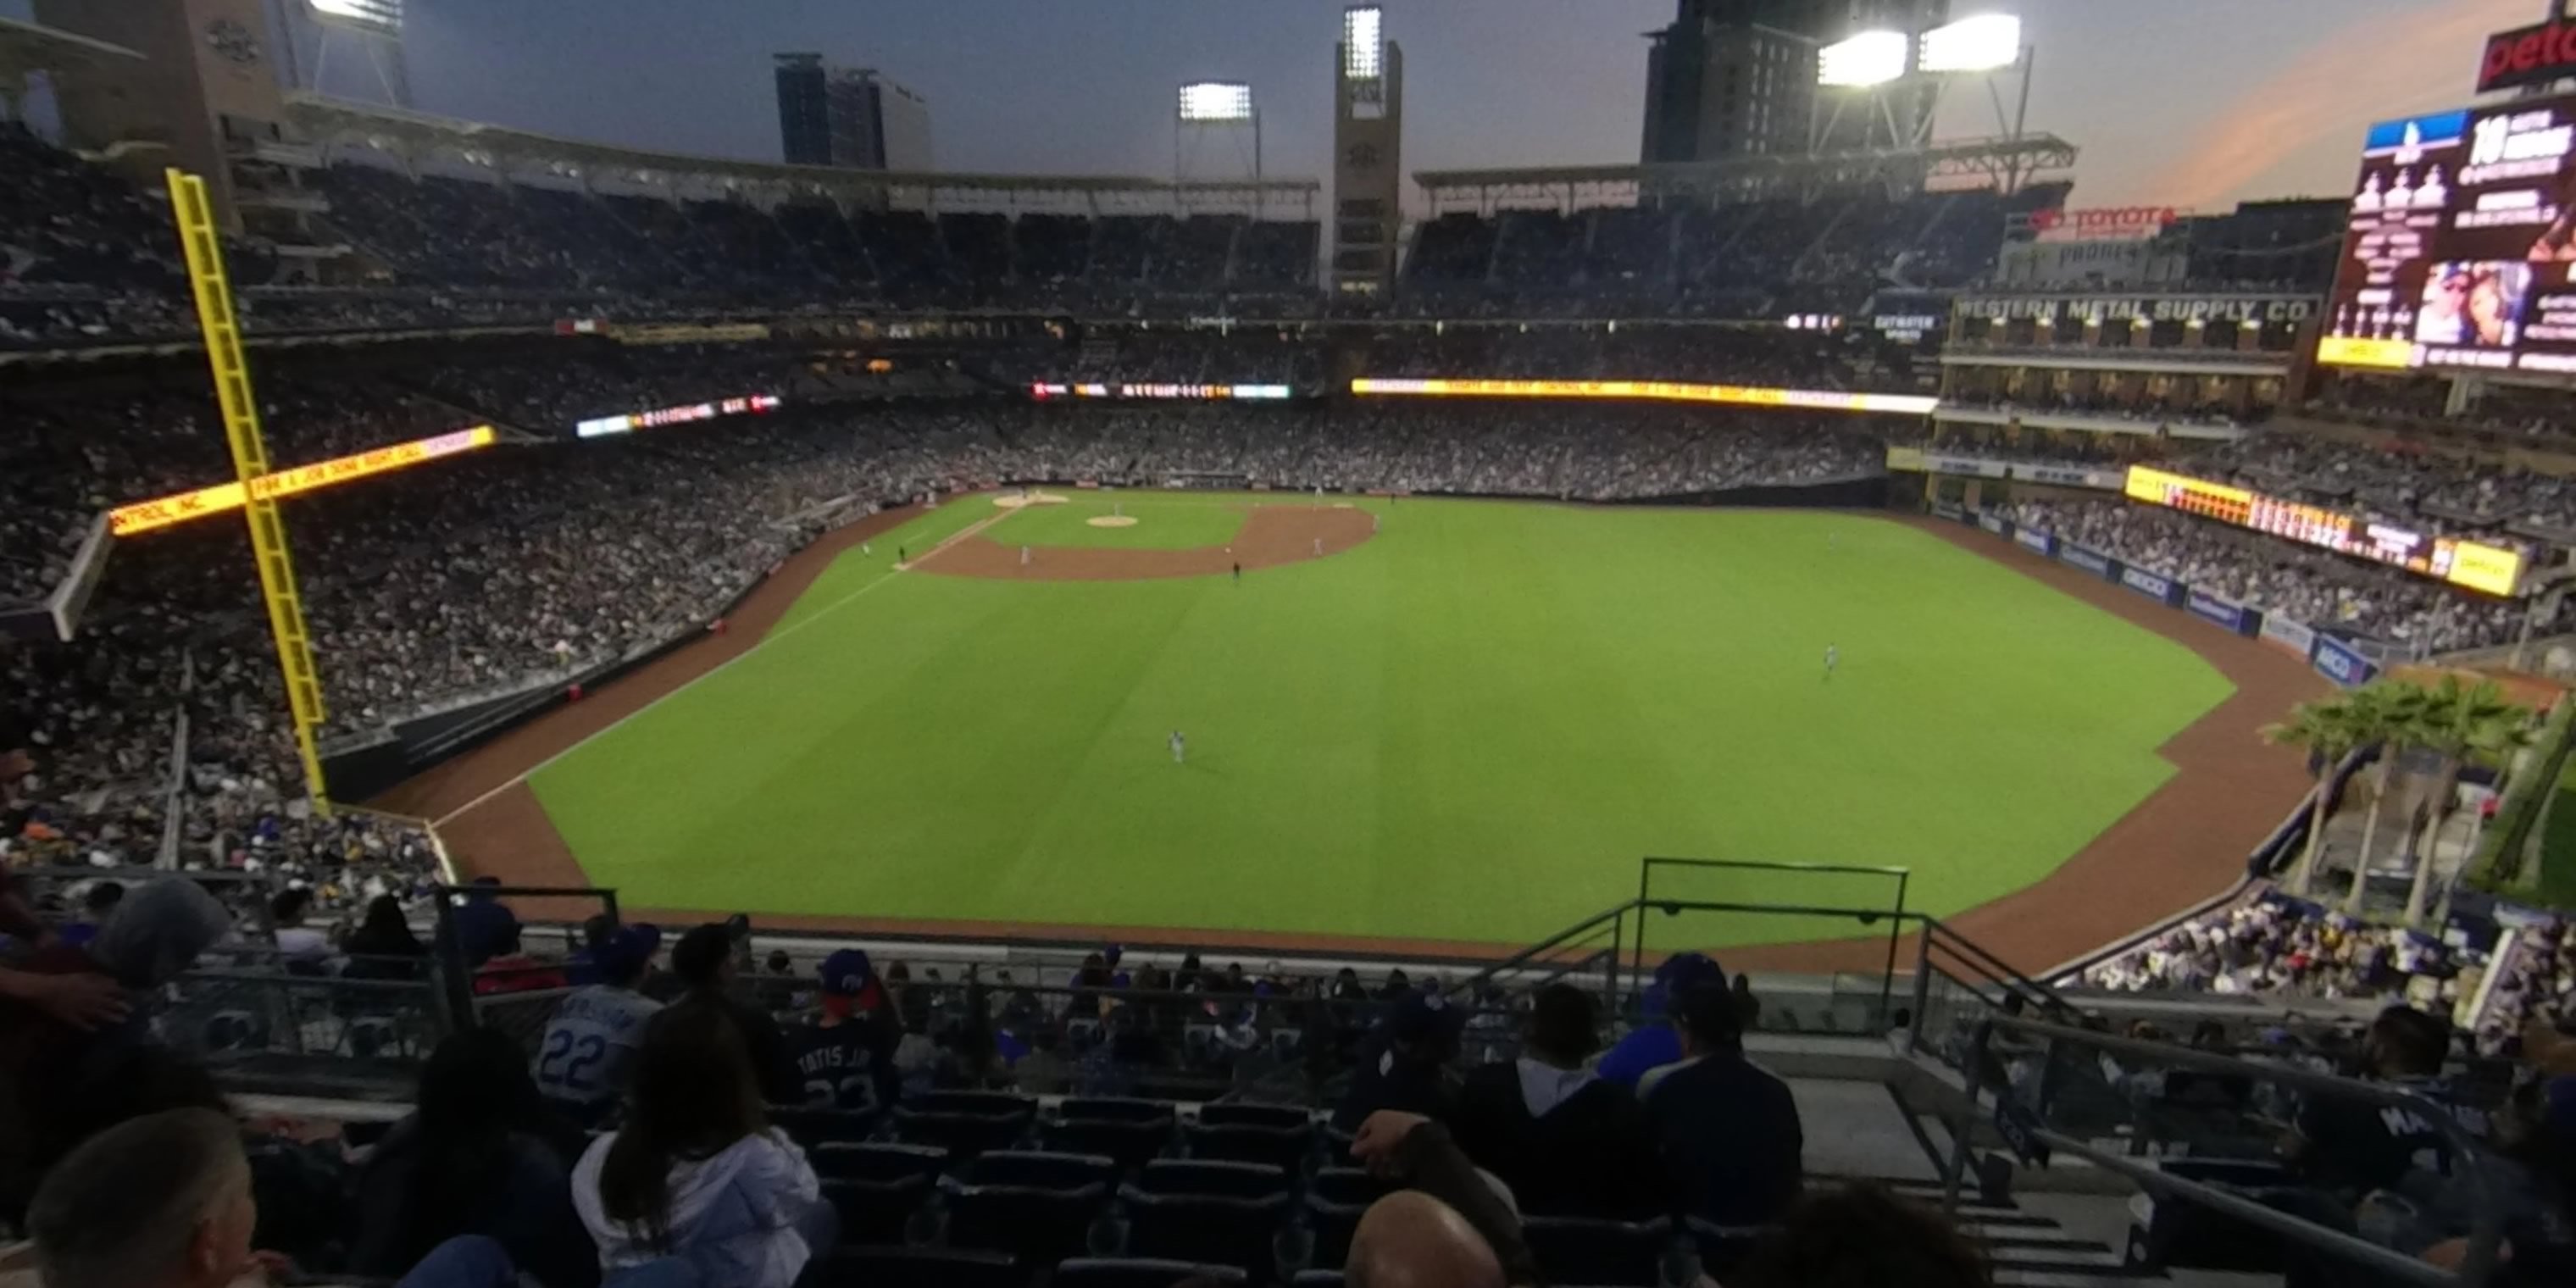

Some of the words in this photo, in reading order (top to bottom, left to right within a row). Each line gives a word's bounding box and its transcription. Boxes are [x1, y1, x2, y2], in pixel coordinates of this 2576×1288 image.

[2484, 23, 2576, 82] petc
[2076, 208, 2177, 227] TOYOTA
[1958, 300, 2060, 321] WESTERN
[2067, 300, 2145, 320] METAL
[2153, 300, 2257, 321] SUPPLY
[2266, 300, 2310, 321] CO
[541, 1029, 606, 1091] 22
[797, 1044, 843, 1074] TATIS
